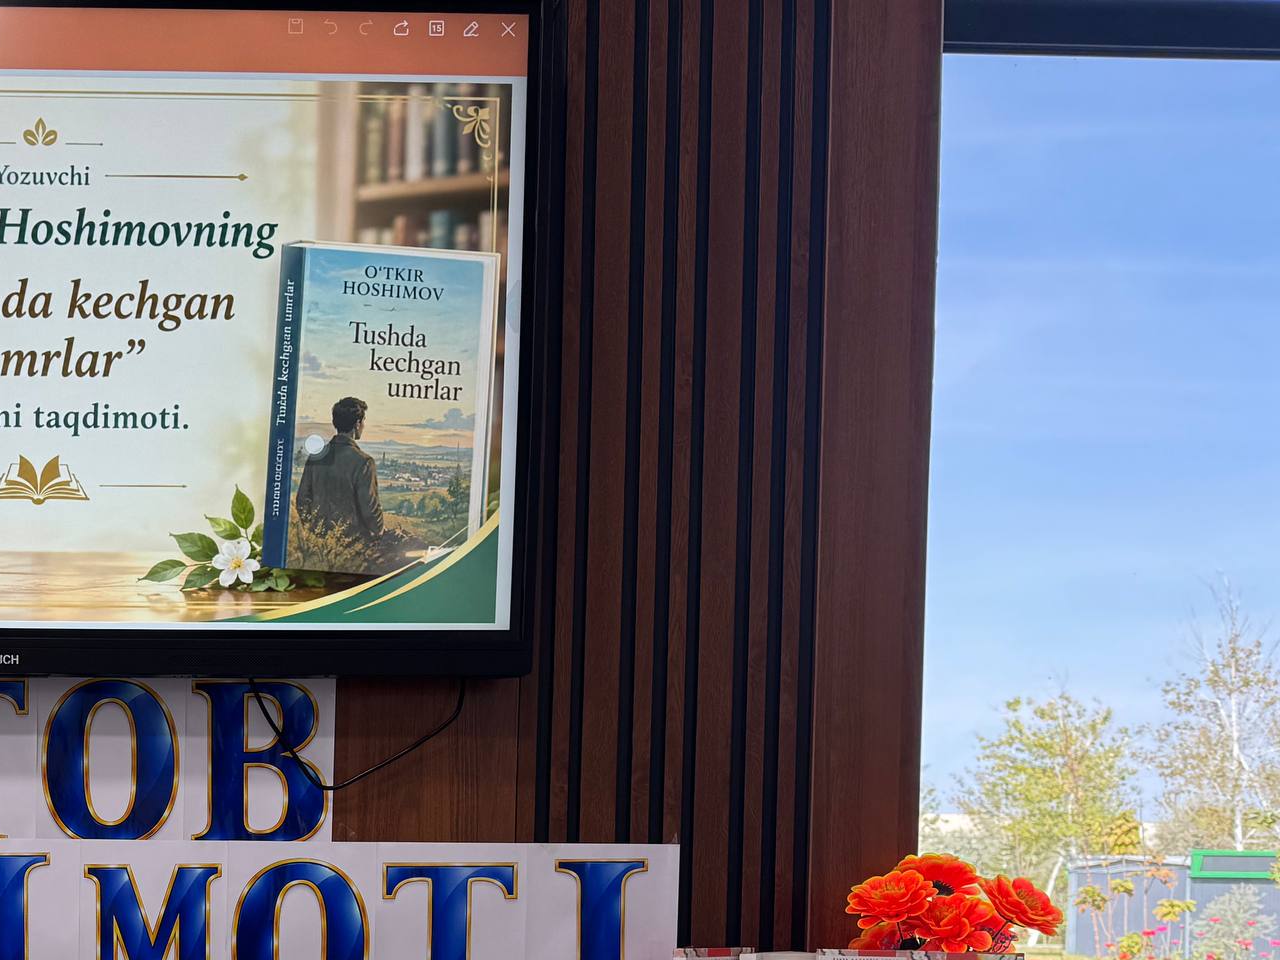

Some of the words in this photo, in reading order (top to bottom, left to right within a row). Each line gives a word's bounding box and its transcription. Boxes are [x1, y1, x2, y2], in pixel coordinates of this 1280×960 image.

[67, 278, 235, 331] kechgan
[342, 281, 445, 301] HOSHIMOV
[349, 320, 427, 348] Tushda
[369, 349, 462, 381] kechgan
[388, 378, 463, 401] umrlar
[33, 402, 189, 437] taqdimoti.
